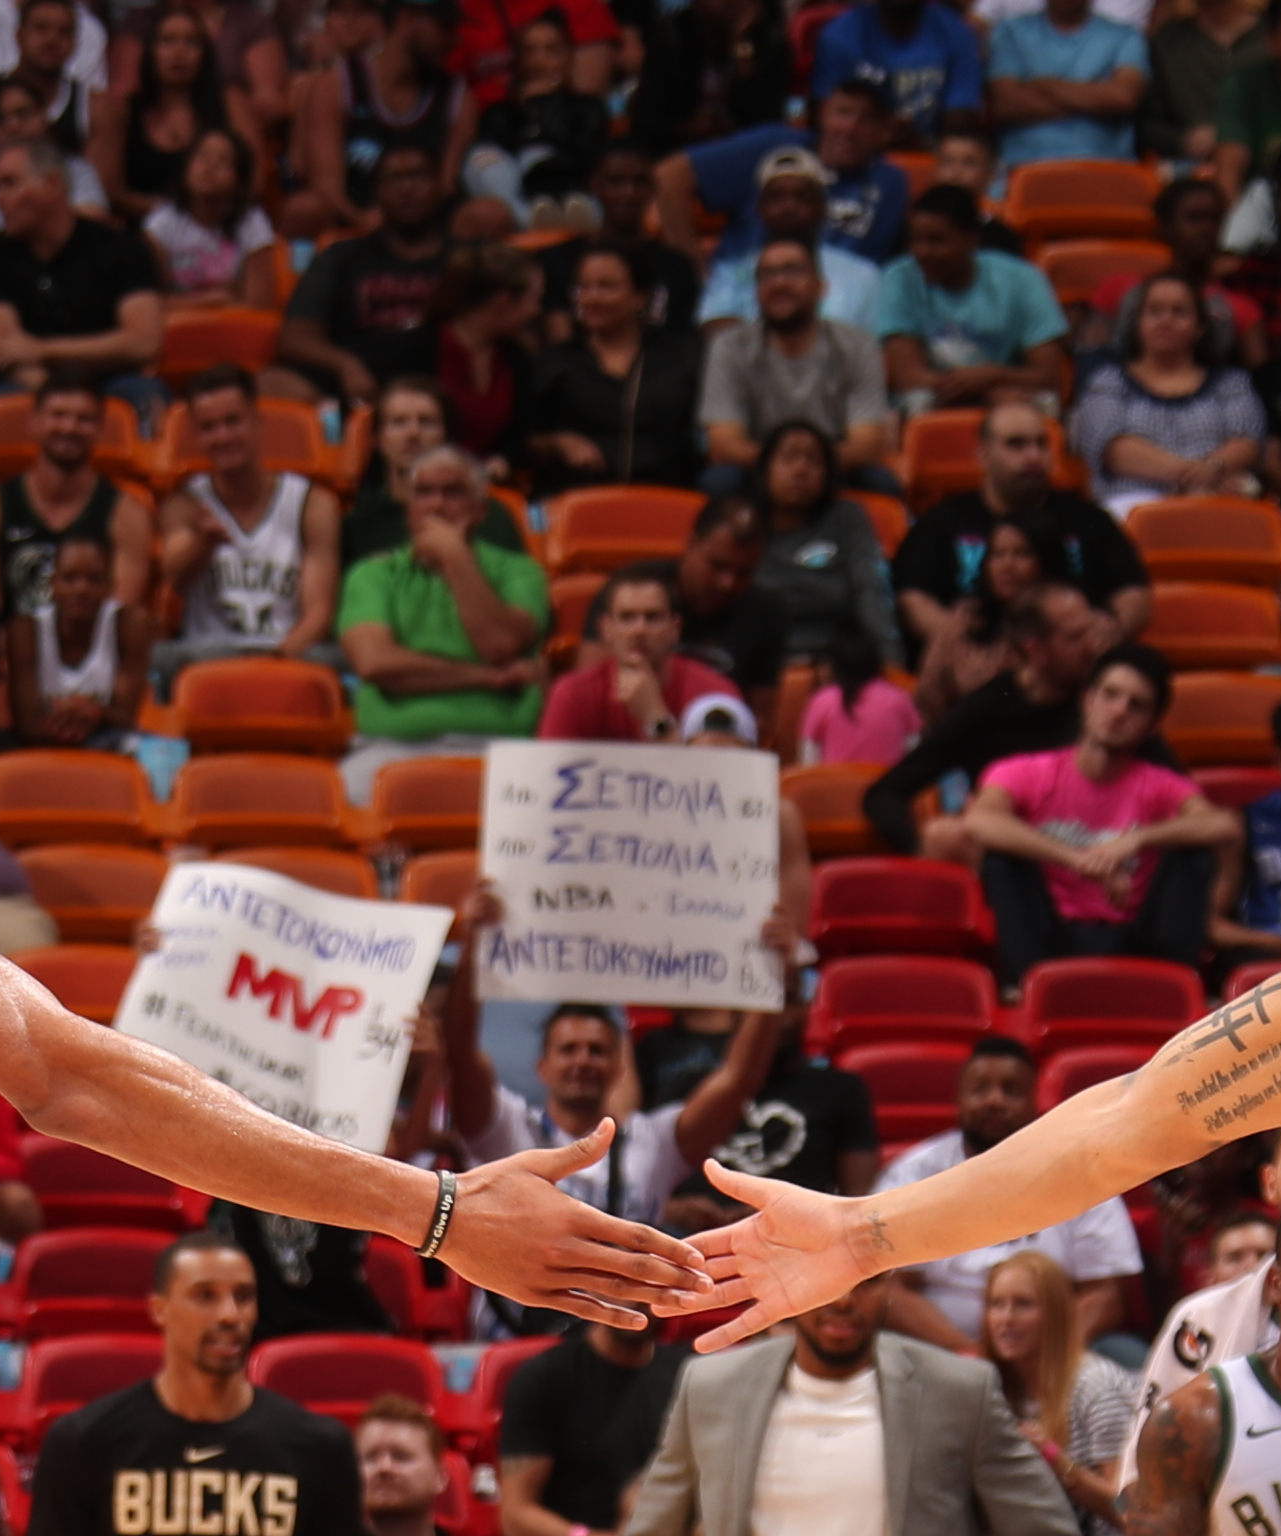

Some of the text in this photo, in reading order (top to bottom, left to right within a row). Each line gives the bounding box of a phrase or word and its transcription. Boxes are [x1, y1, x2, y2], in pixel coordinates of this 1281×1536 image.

[226, 951, 366, 1041] MVP
[433, 1212, 449, 1238] Give
[441, 1194, 454, 1211] Up
